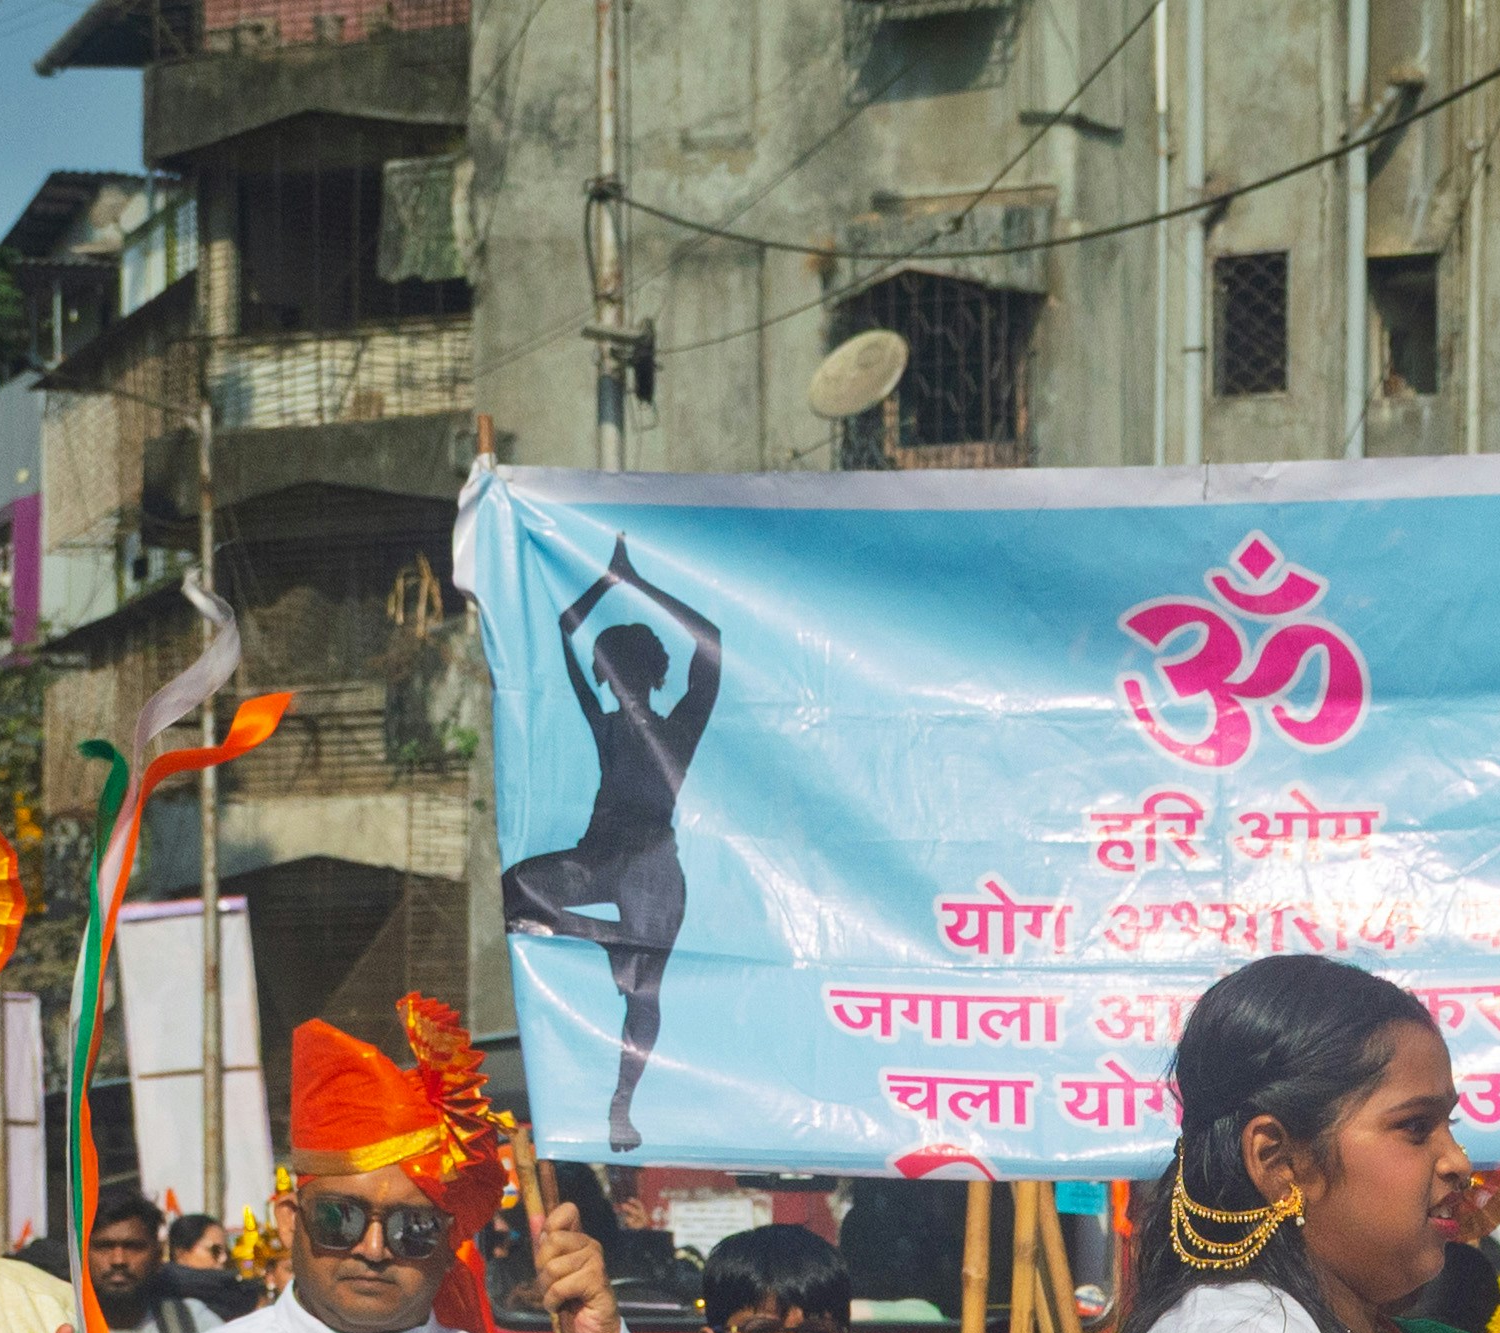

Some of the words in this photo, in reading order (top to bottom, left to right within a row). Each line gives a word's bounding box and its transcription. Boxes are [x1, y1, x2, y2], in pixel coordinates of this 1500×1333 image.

[1090, 791, 1204, 872] हरि
[1234, 789, 1380, 861] ओम
[942, 880, 1073, 954] योग
[829, 989, 1065, 1043] जगाला
[886, 1073, 1034, 1125] चला
